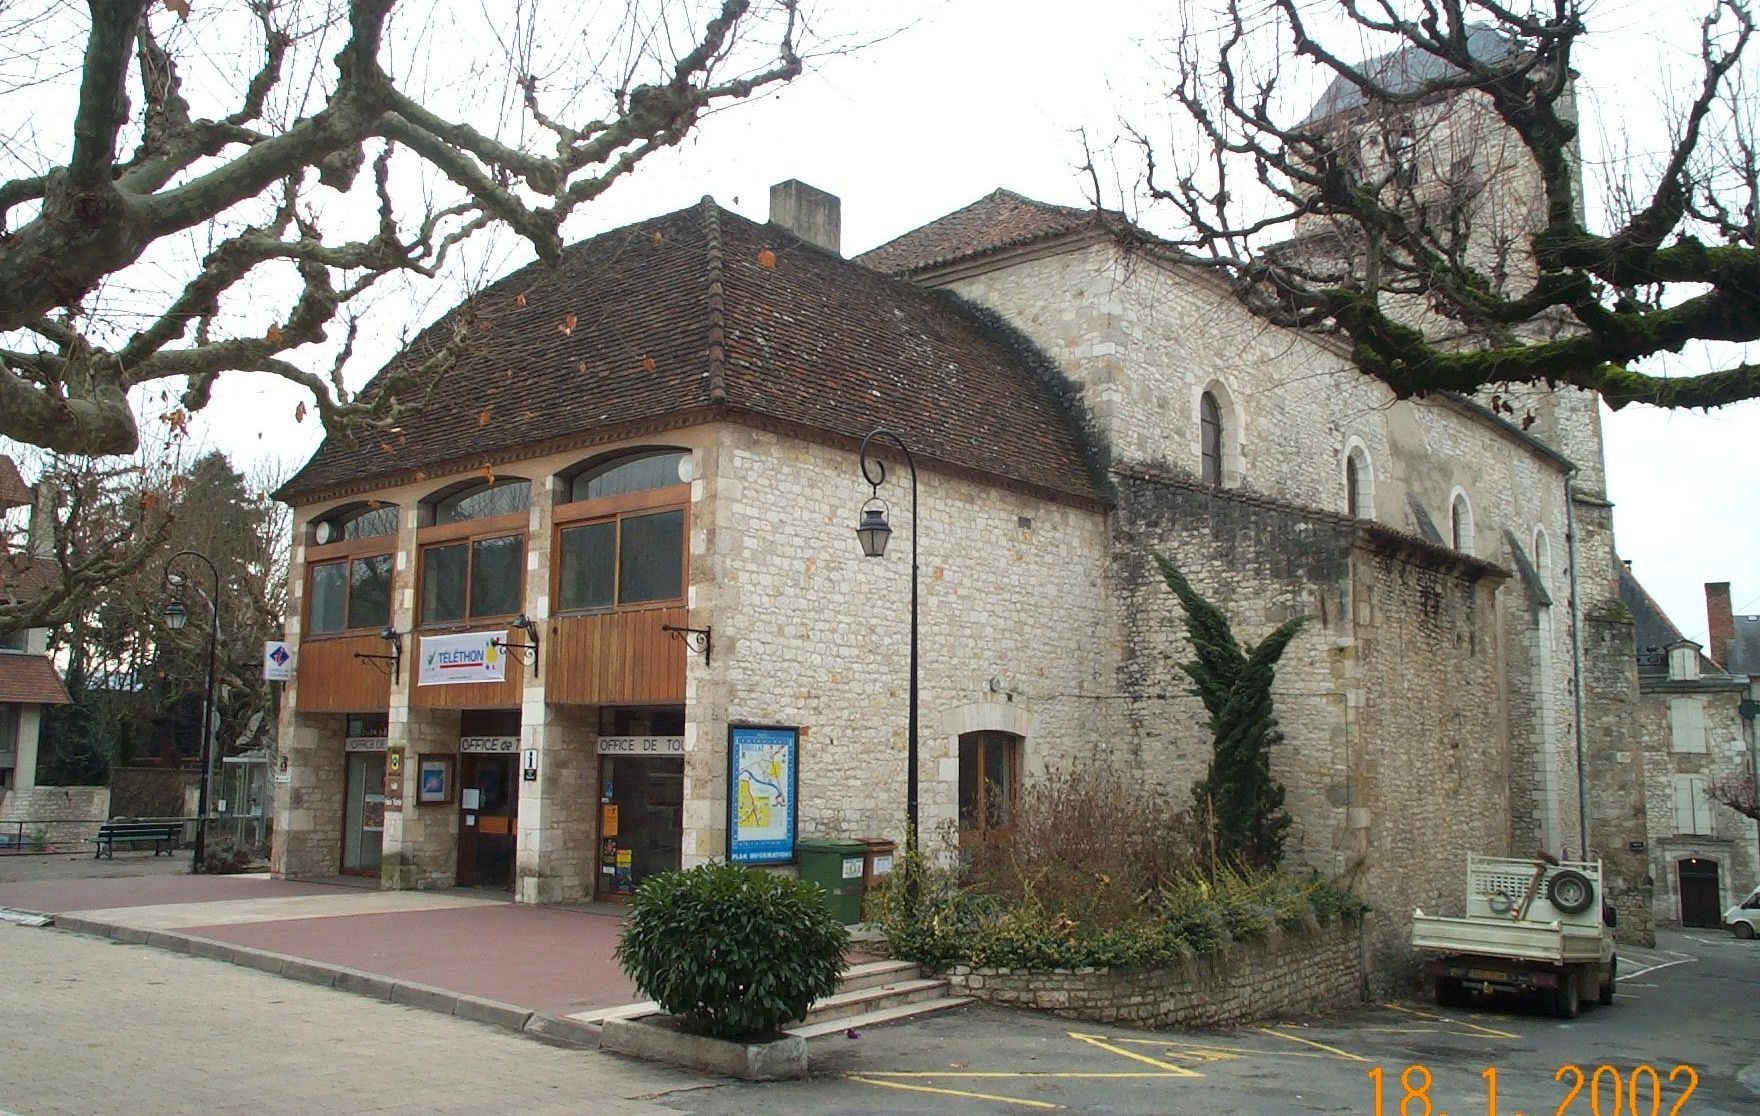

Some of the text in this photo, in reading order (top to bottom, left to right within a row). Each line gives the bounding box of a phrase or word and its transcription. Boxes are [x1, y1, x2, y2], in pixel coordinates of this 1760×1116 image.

[438, 648, 484, 664] TÉLÉTHON
[462, 738, 499, 751] OFFICE
[500, 740, 512, 751] de
[600, 739, 635, 751] OFFICE
[643, 739, 658, 751] DE
